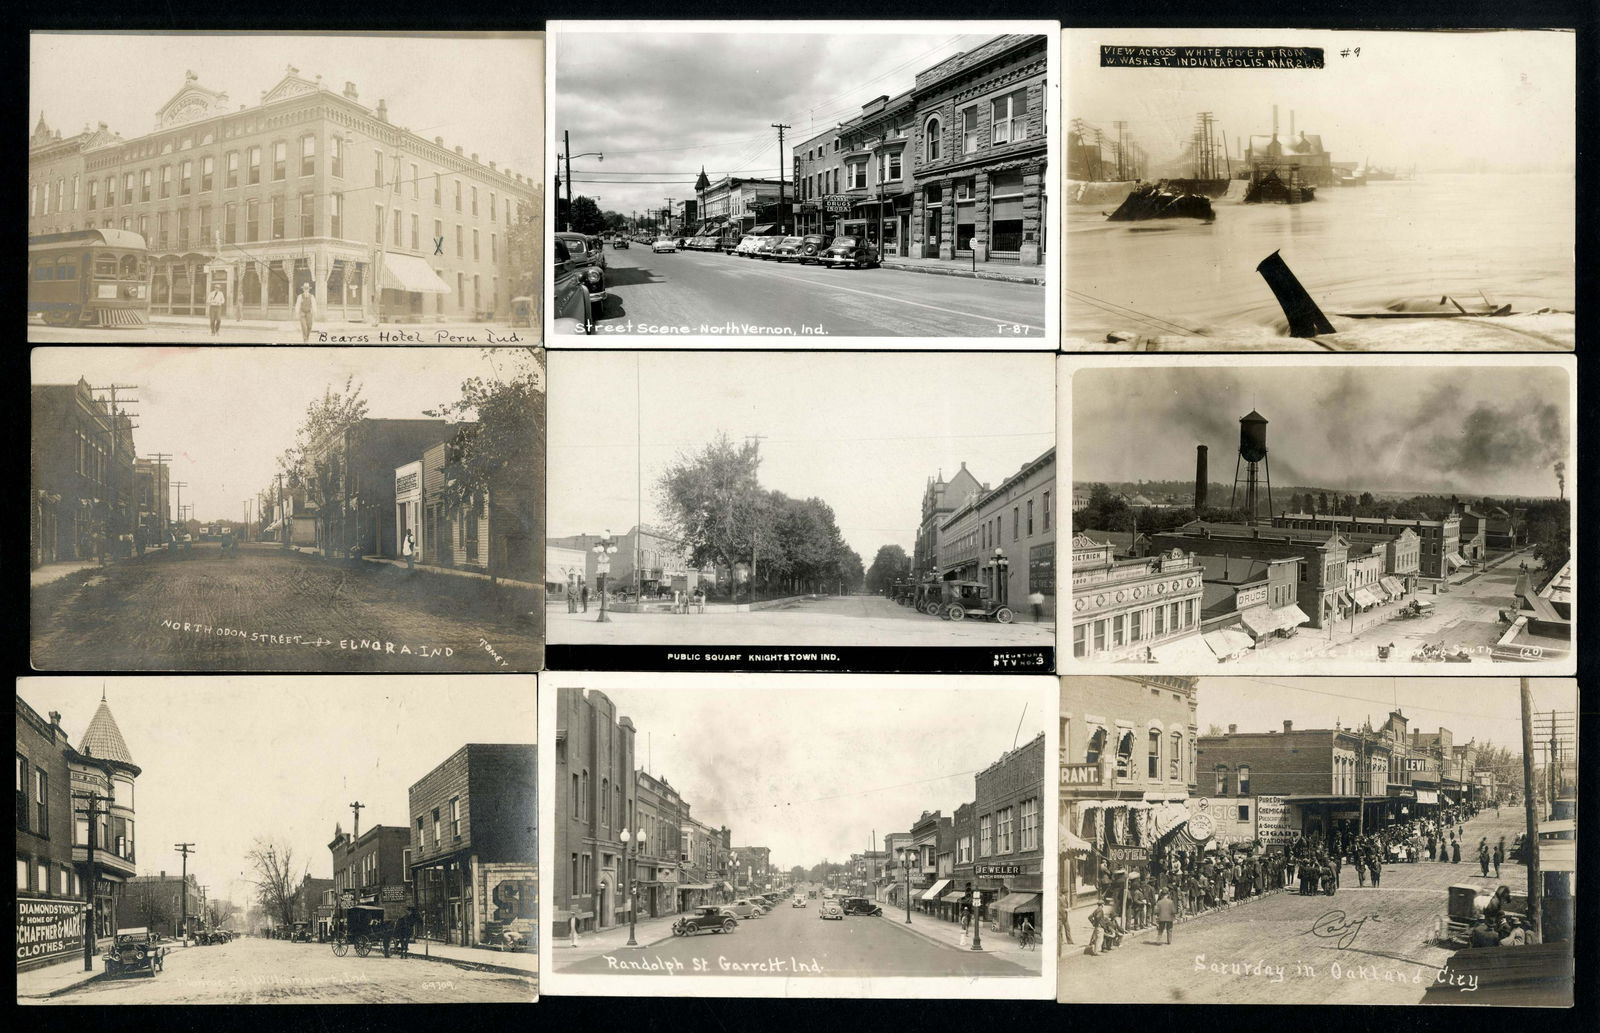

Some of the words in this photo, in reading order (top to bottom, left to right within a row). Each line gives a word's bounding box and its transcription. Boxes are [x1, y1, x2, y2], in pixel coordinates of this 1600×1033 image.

[318, 331, 369, 343] Bearss
[379, 330, 425, 343] Hotel
[435, 330, 477, 343] Peru
[1406, 759, 1425, 771] LEVI
[1061, 767, 1099, 783] RANT.
[1109, 848, 1147, 861] HOTEL
[19, 903, 76, 914] DIAMONDSTONE
[27, 916, 46, 924] HOME
